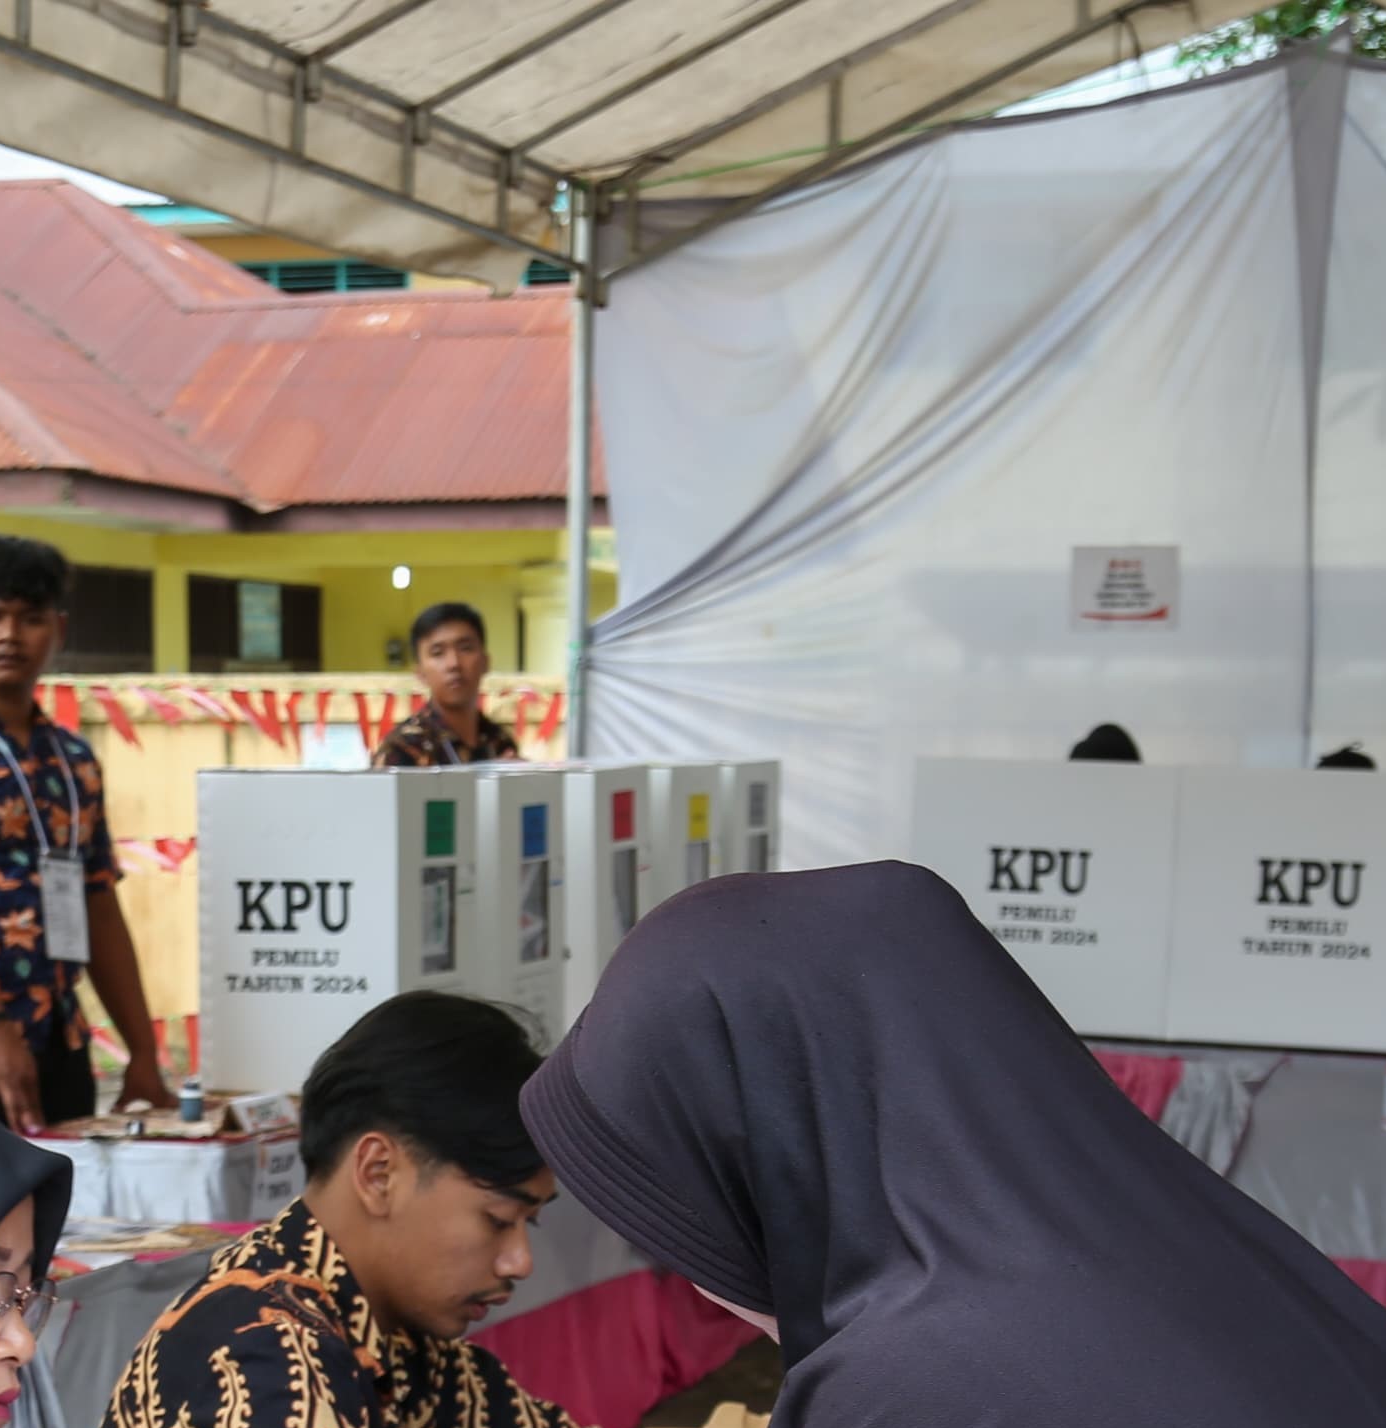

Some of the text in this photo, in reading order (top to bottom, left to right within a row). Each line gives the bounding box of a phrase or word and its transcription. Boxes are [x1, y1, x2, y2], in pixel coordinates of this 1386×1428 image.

[988, 847, 1092, 894] KPU
[1256, 858, 1366, 908] KPU
[236, 880, 354, 933] KPU
[999, 905, 1077, 923] PEMILU
[991, 926, 1099, 946] AHUN 2024
[1267, 917, 1348, 936] PEMILU
[251, 949, 341, 968] PEMILU
[1242, 937, 1372, 960] TAHUN 2024
[225, 975, 369, 994] TAHUN 2024
